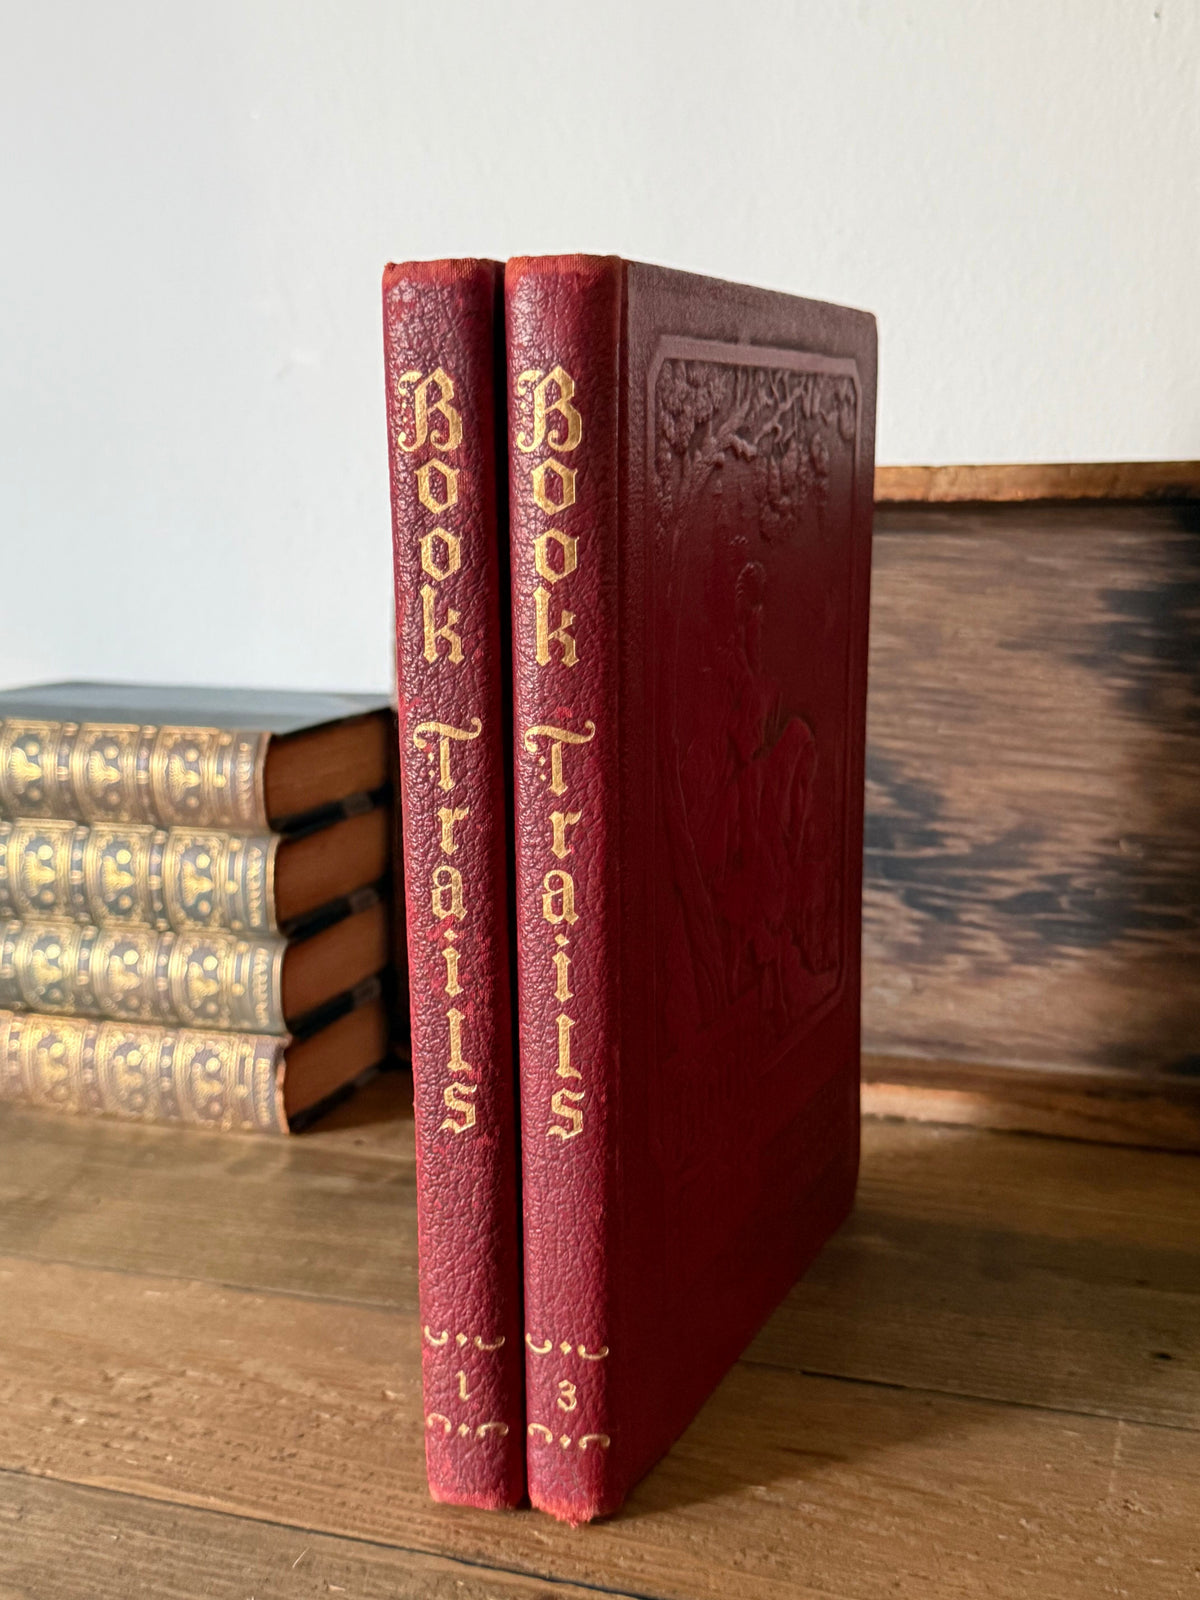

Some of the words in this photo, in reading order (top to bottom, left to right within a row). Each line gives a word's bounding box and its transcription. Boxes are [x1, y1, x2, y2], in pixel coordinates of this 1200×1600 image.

[397, 367, 464, 664] Book
[516, 366, 583, 668] Book
[413, 718, 483, 1134] Trails
[524, 720, 596, 1141] Trails
[455, 1370, 471, 1401] 1
[557, 1379, 577, 1412] 3
